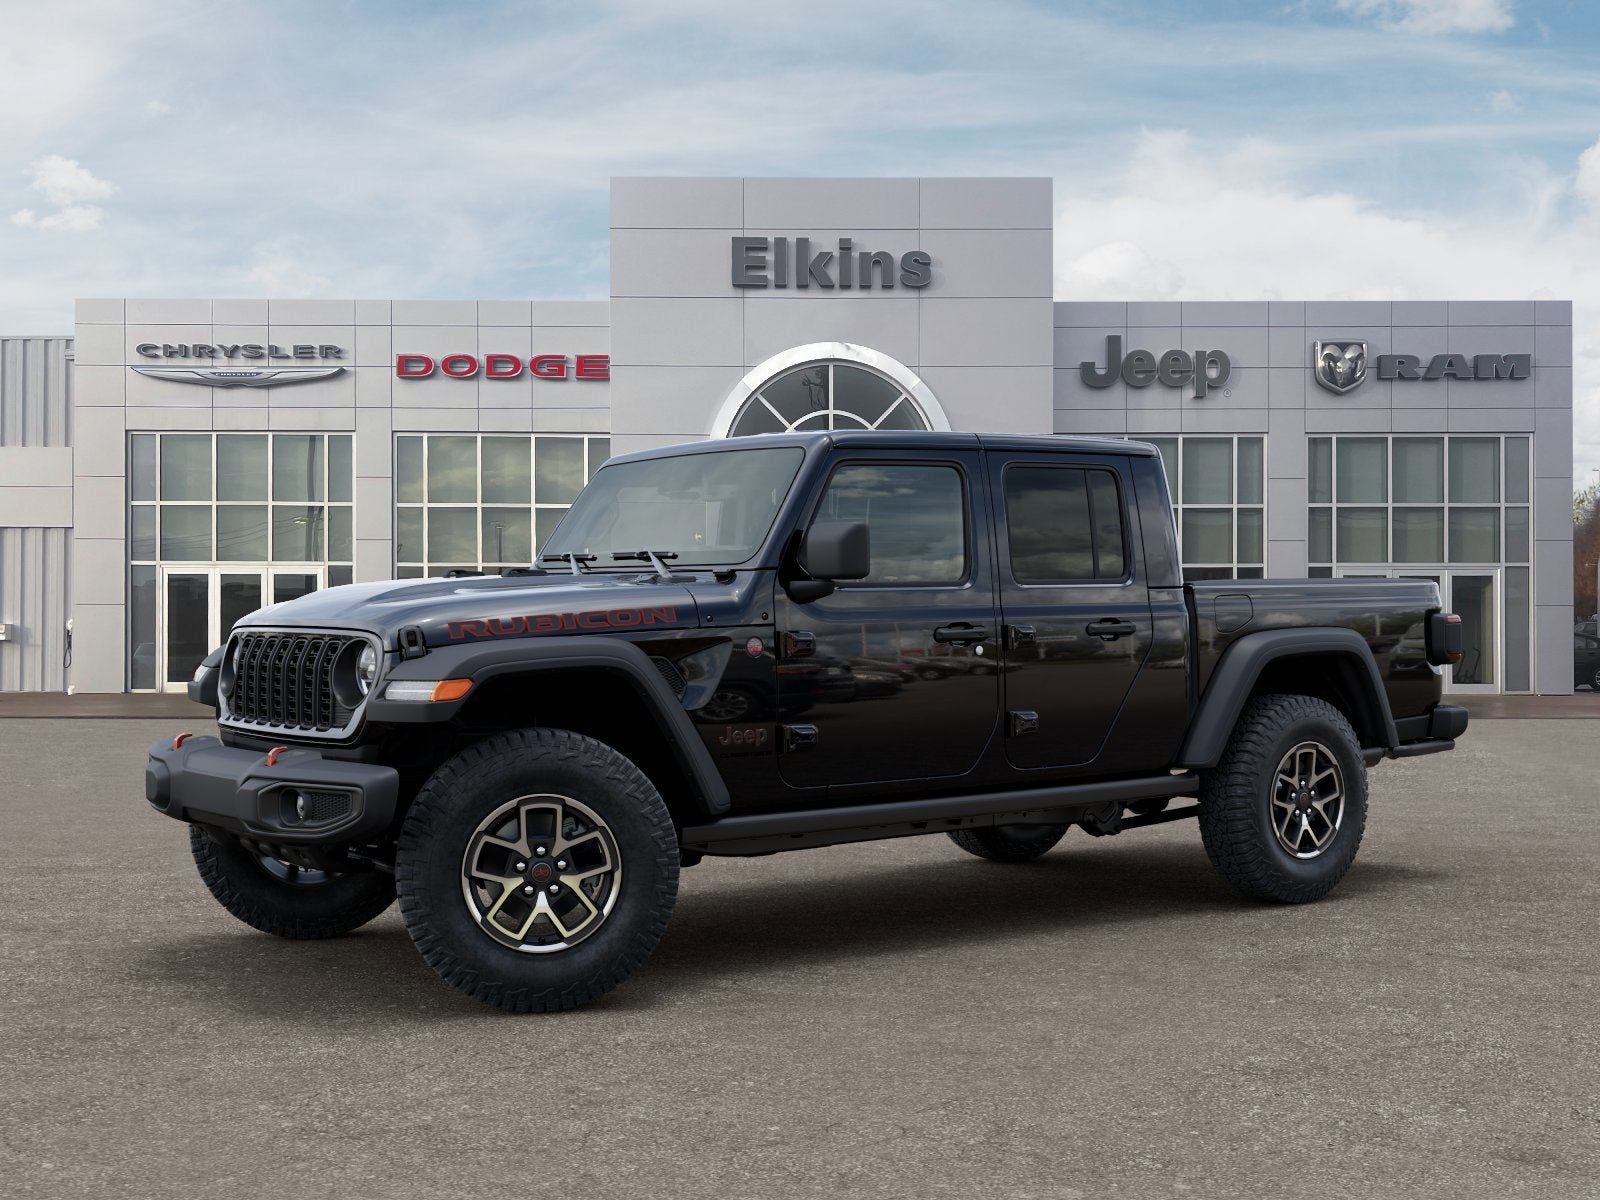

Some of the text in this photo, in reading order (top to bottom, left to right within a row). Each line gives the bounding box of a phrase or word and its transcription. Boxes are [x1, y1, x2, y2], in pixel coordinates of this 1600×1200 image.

[731, 236, 932, 289] Elkins
[135, 343, 343, 360] CHRYSLER
[395, 353, 610, 379] DODGE
[1079, 334, 1231, 398] Jeep
[1376, 353, 1531, 381] RAM
[448, 605, 678, 640] RUBICON
[716, 726, 768, 747] Jeep
